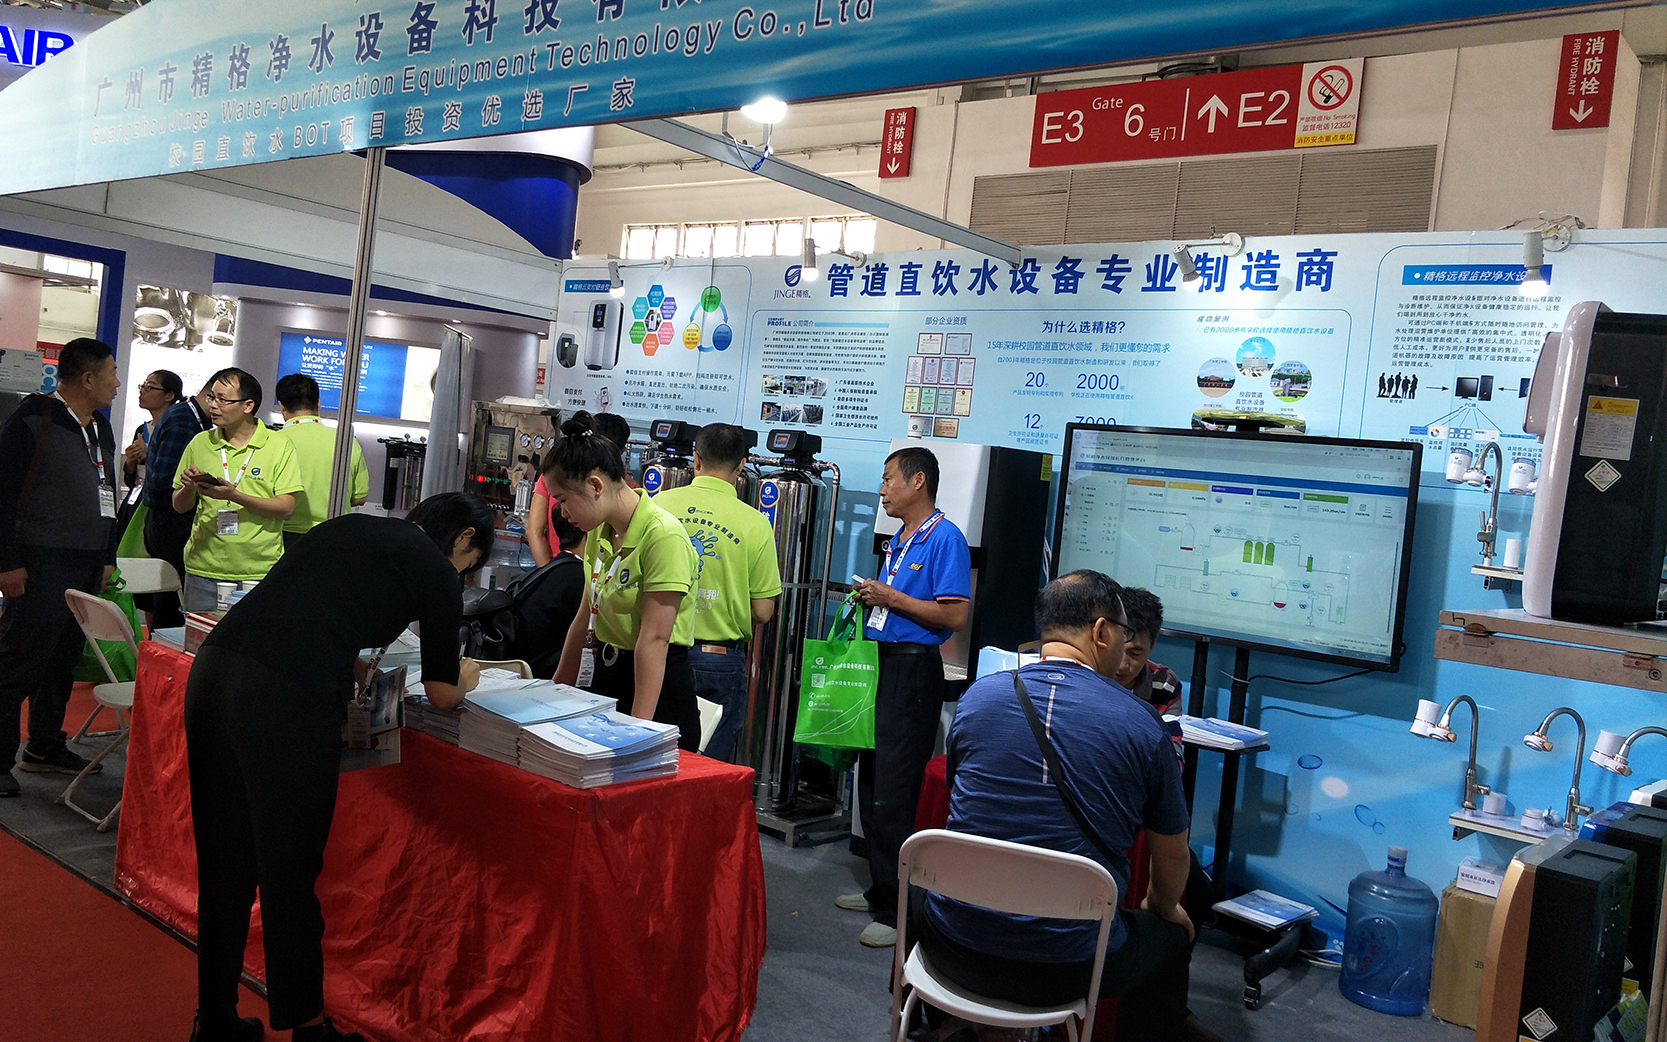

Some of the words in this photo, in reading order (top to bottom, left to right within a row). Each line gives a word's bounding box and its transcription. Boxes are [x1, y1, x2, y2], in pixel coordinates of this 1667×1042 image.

[1572, 38, 1581, 55] FIRE
[1580, 36, 1605, 95] 消防栓
[91, 117, 167, 145] Guangzhou
[169, 111, 209, 135] Jinge
[221, 72, 395, 123] Water-purification
[402, 45, 536, 93] Equipment
[546, 19, 722, 69] Technology
[732, 0, 875, 41] Co.,Ltd
[1567, 57, 1579, 95] HYDRANT
[1041, 110, 1084, 145] E3
[1092, 96, 1124, 111] Gate
[1148, 126, 1177, 142] 号门
[1237, 89, 1291, 128] E2
[893, 111, 907, 154] 消防栓
[1296, 133, 1353, 144] 消防安全重点单位
[827, 248, 1338, 298] 管道直饮水设备专业制造商
[925, 316, 967, 325] 部分企业资质
[302, 355, 328, 364] WORK
[303, 347, 338, 357] MAKING
[312, 338, 342, 346] PENTAIR
